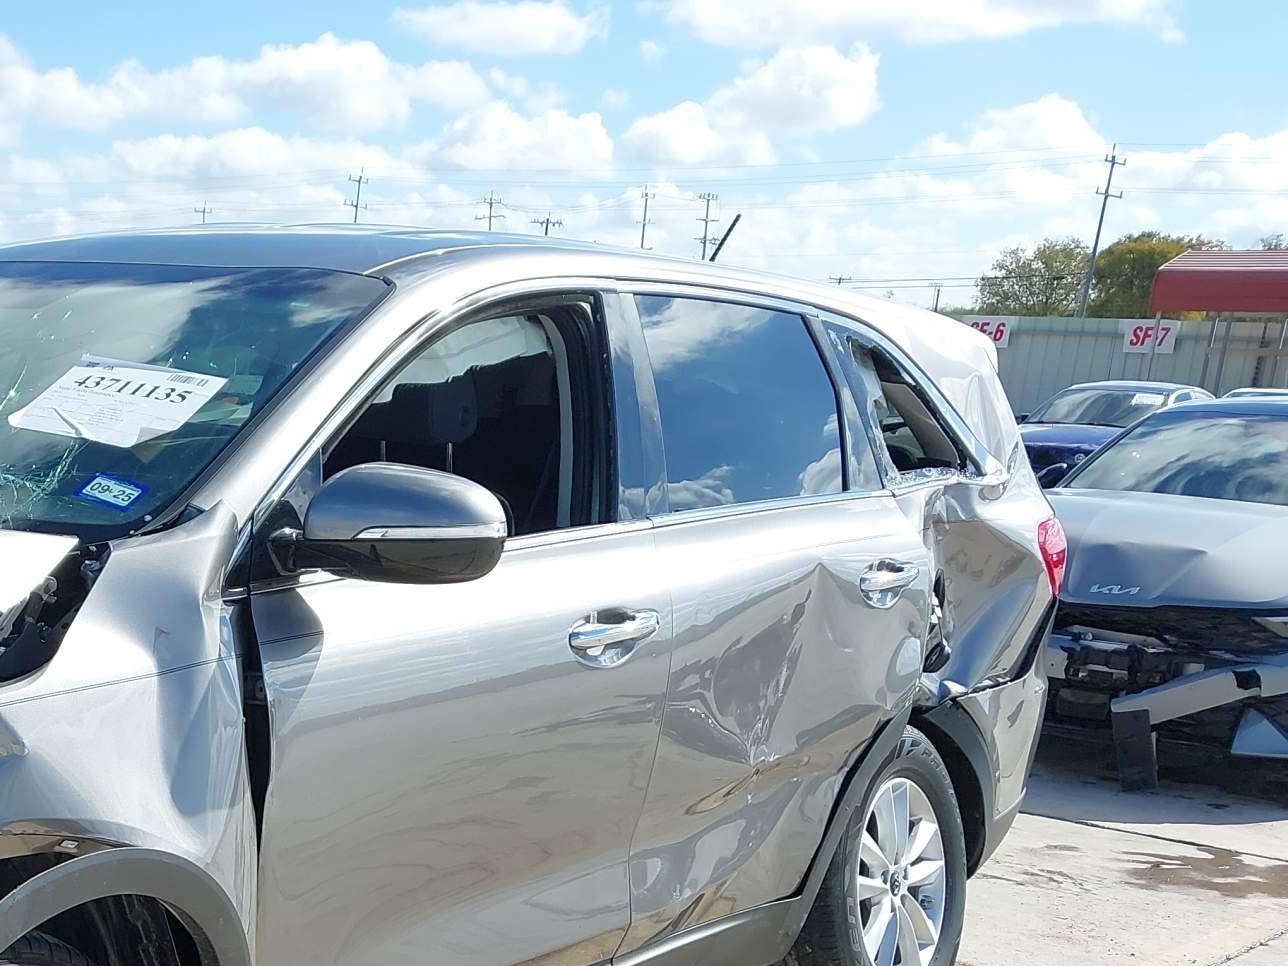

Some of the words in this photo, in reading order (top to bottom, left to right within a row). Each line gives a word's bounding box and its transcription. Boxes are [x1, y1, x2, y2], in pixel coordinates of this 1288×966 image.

[1129, 325, 1171, 347] SF7
[73, 373, 193, 405] 43711135
[90, 482, 107, 495] 09
[112, 488, 133, 503] 25
